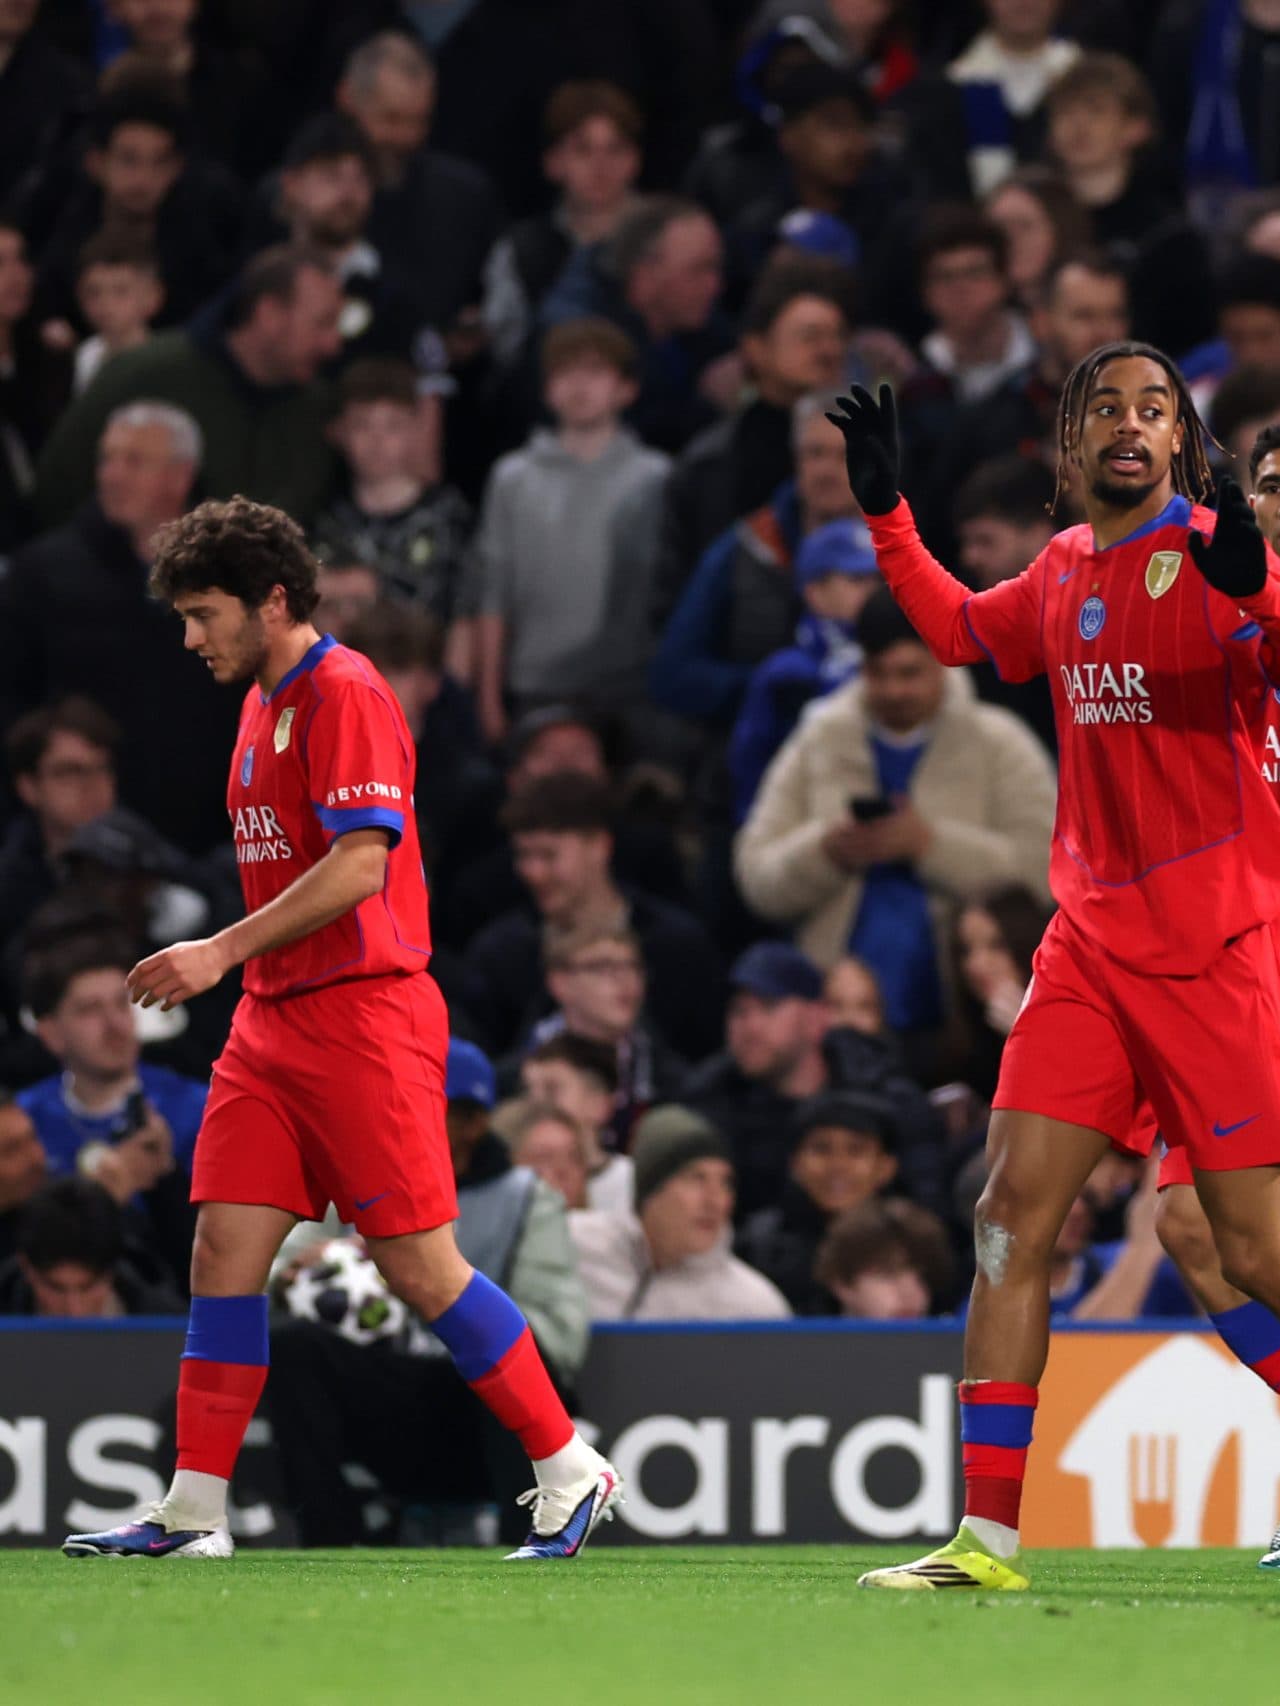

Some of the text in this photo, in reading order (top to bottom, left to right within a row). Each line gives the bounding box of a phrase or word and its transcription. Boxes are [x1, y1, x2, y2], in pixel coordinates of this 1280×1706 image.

[1060, 663, 1150, 708] QATAR
[1074, 701, 1153, 725] AIRWAYS
[327, 781, 402, 806] BEYOND
[229, 804, 285, 840] ATAR
